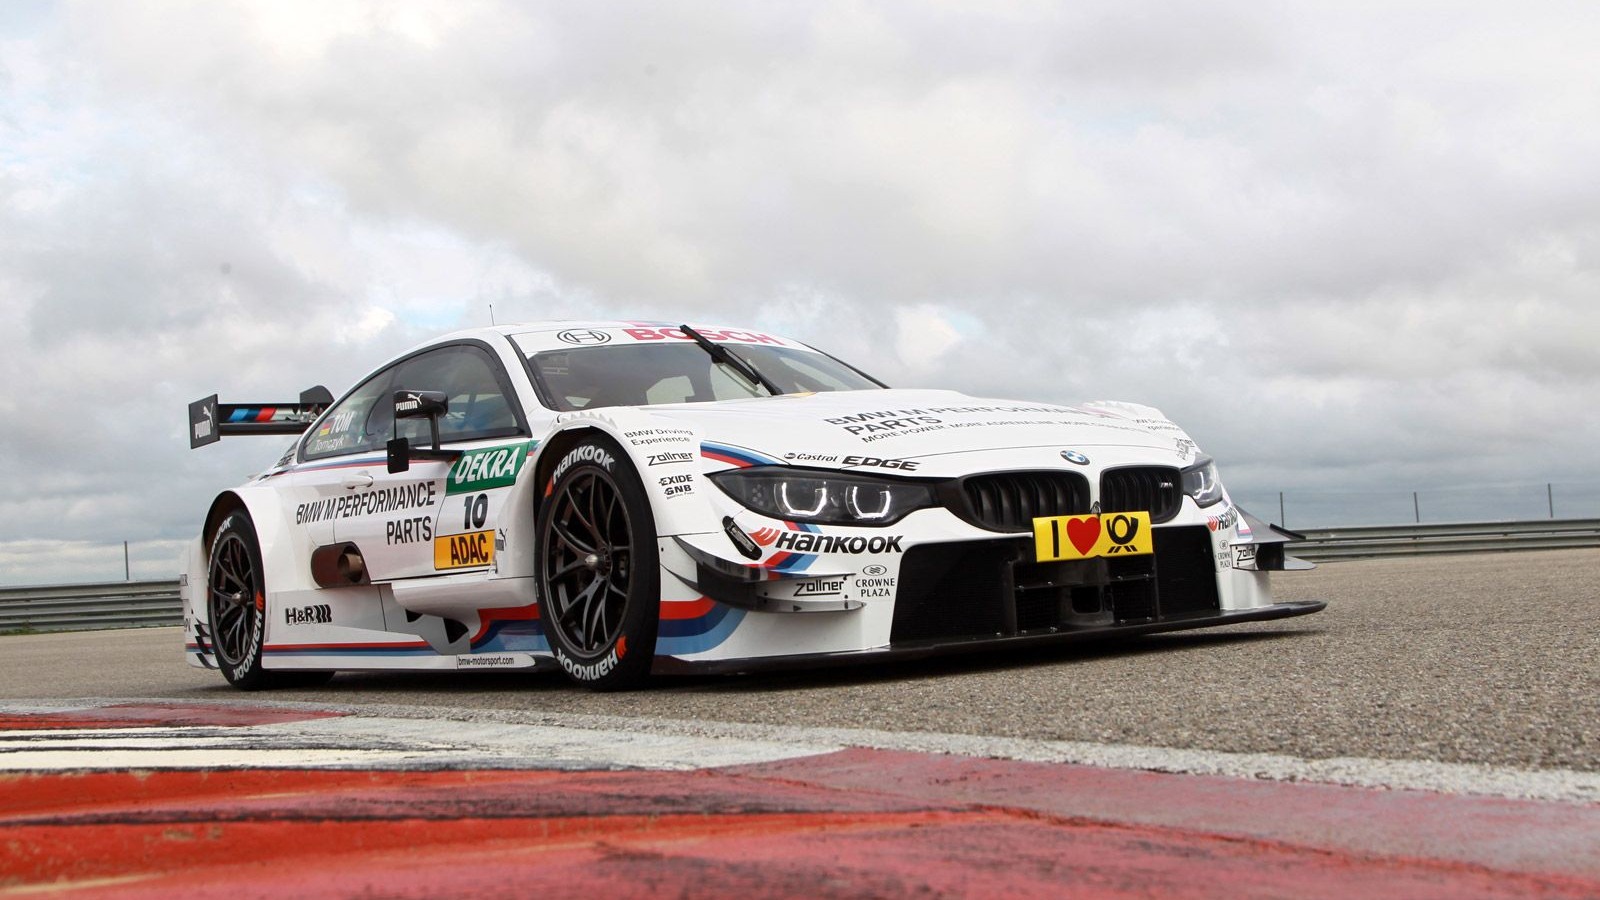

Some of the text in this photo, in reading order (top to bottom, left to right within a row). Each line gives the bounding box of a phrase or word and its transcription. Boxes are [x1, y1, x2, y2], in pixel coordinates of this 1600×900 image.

[623, 328, 785, 345] BOSCH
[395, 400, 418, 412] PUMA
[330, 411, 356, 434] TOM
[823, 410, 897, 425] BMW
[898, 408, 926, 416] M
[624, 428, 694, 438] BMW Driving
[843, 416, 943, 436] PARTS
[631, 437, 690, 446] Experience
[861, 430, 901, 444] MORE
[455, 447, 520, 485] DEKRA
[796, 453, 921, 472] Castrol EDGE
[658, 474, 694, 487] EXIDE
[664, 484, 692, 496] GNB
[296, 480, 436, 525] BMW M PERFORMANCE
[464, 493, 489, 530] 10
[386, 516, 432, 545] PARTS
[1051, 519, 1060, 558] I
[450, 532, 489, 566] ADAC
[855, 578, 895, 588] CROWNE
[860, 588, 891, 598] PLAZA
[285, 606, 315, 625] H&R
[458, 655, 515, 667] bmw-motorsport.com
